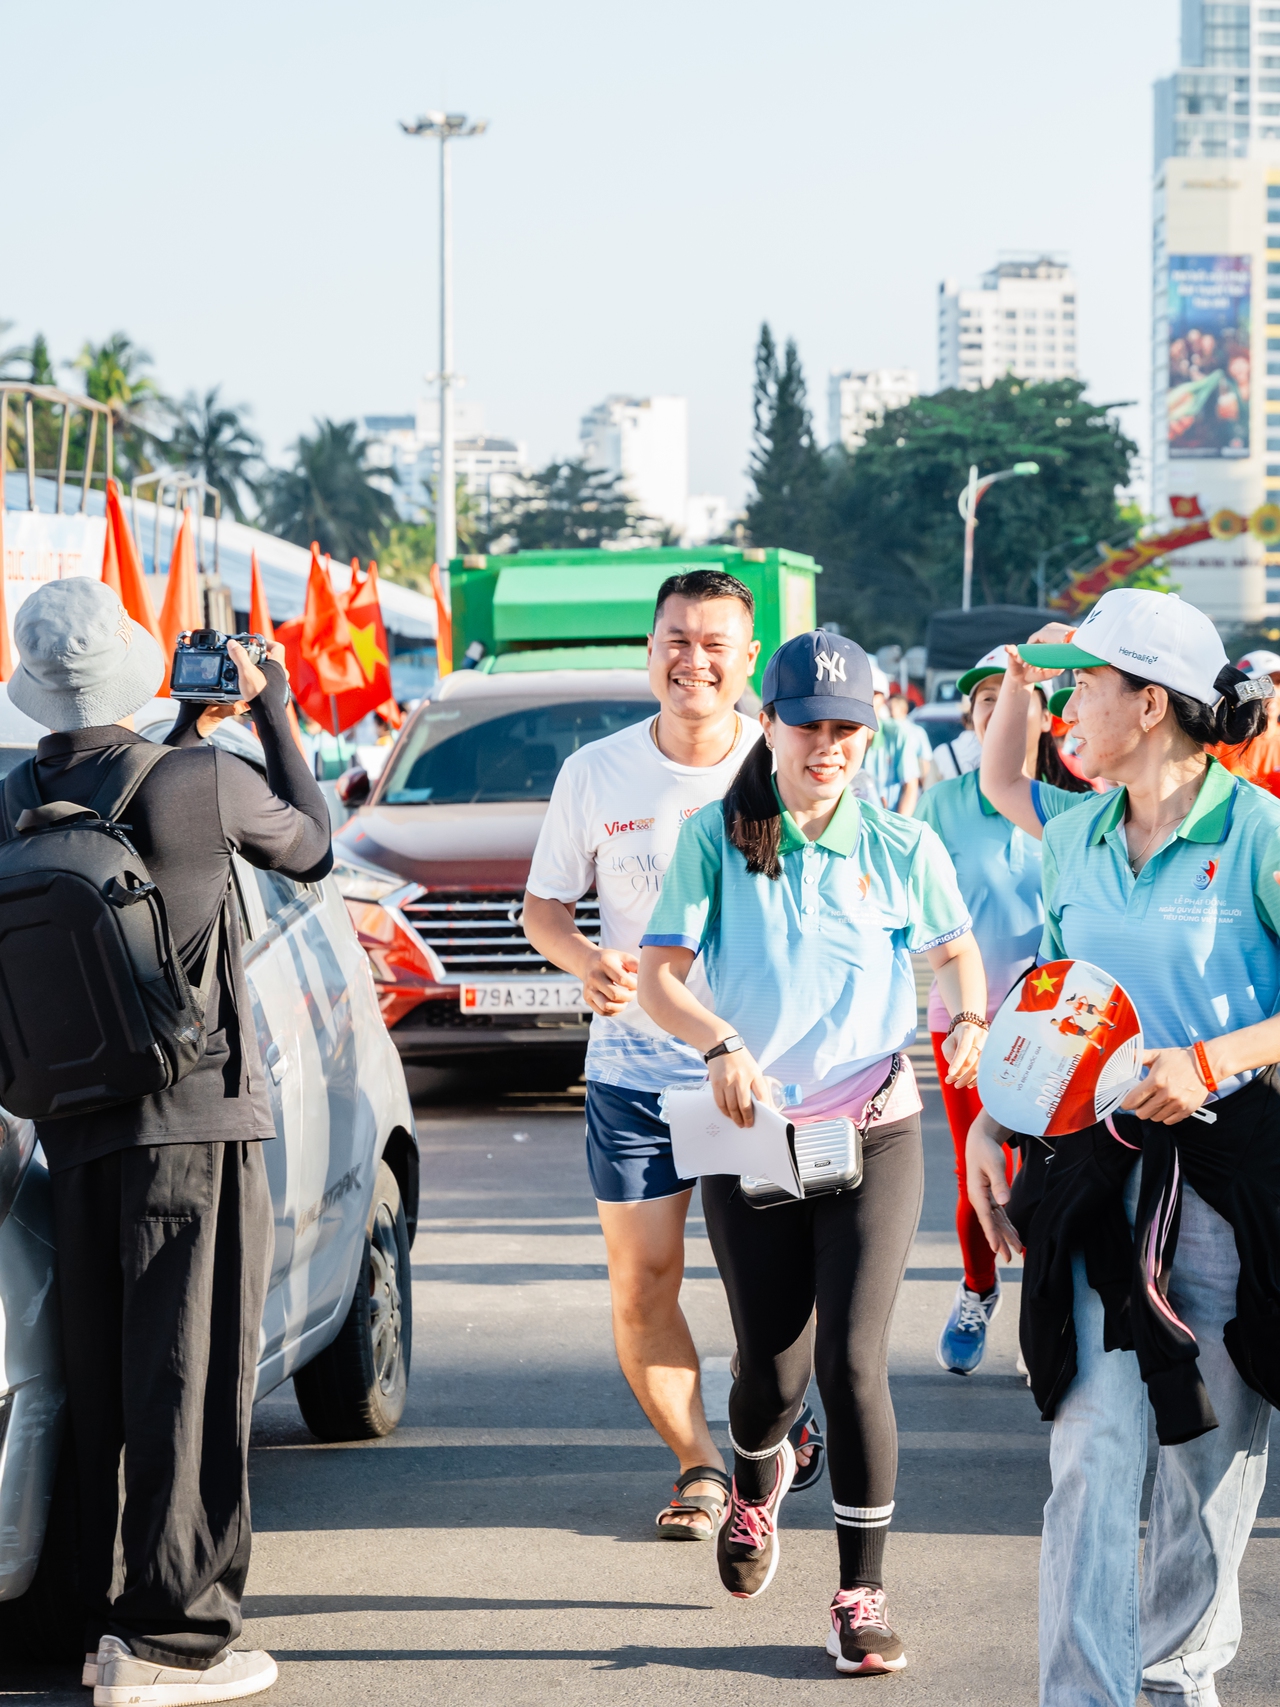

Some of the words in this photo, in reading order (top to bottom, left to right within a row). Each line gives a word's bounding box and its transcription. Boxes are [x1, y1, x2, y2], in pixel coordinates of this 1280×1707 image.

[1118, 646, 1153, 665] Herbalife
[814, 651, 847, 682] NY
[604, 820, 635, 836] Viet
[612, 853, 669, 873] HCMC
[935, 928, 961, 946] RIGHT
[477, 987, 589, 1008] 79A-321.2
[1066, 1053, 1082, 1077] minh
